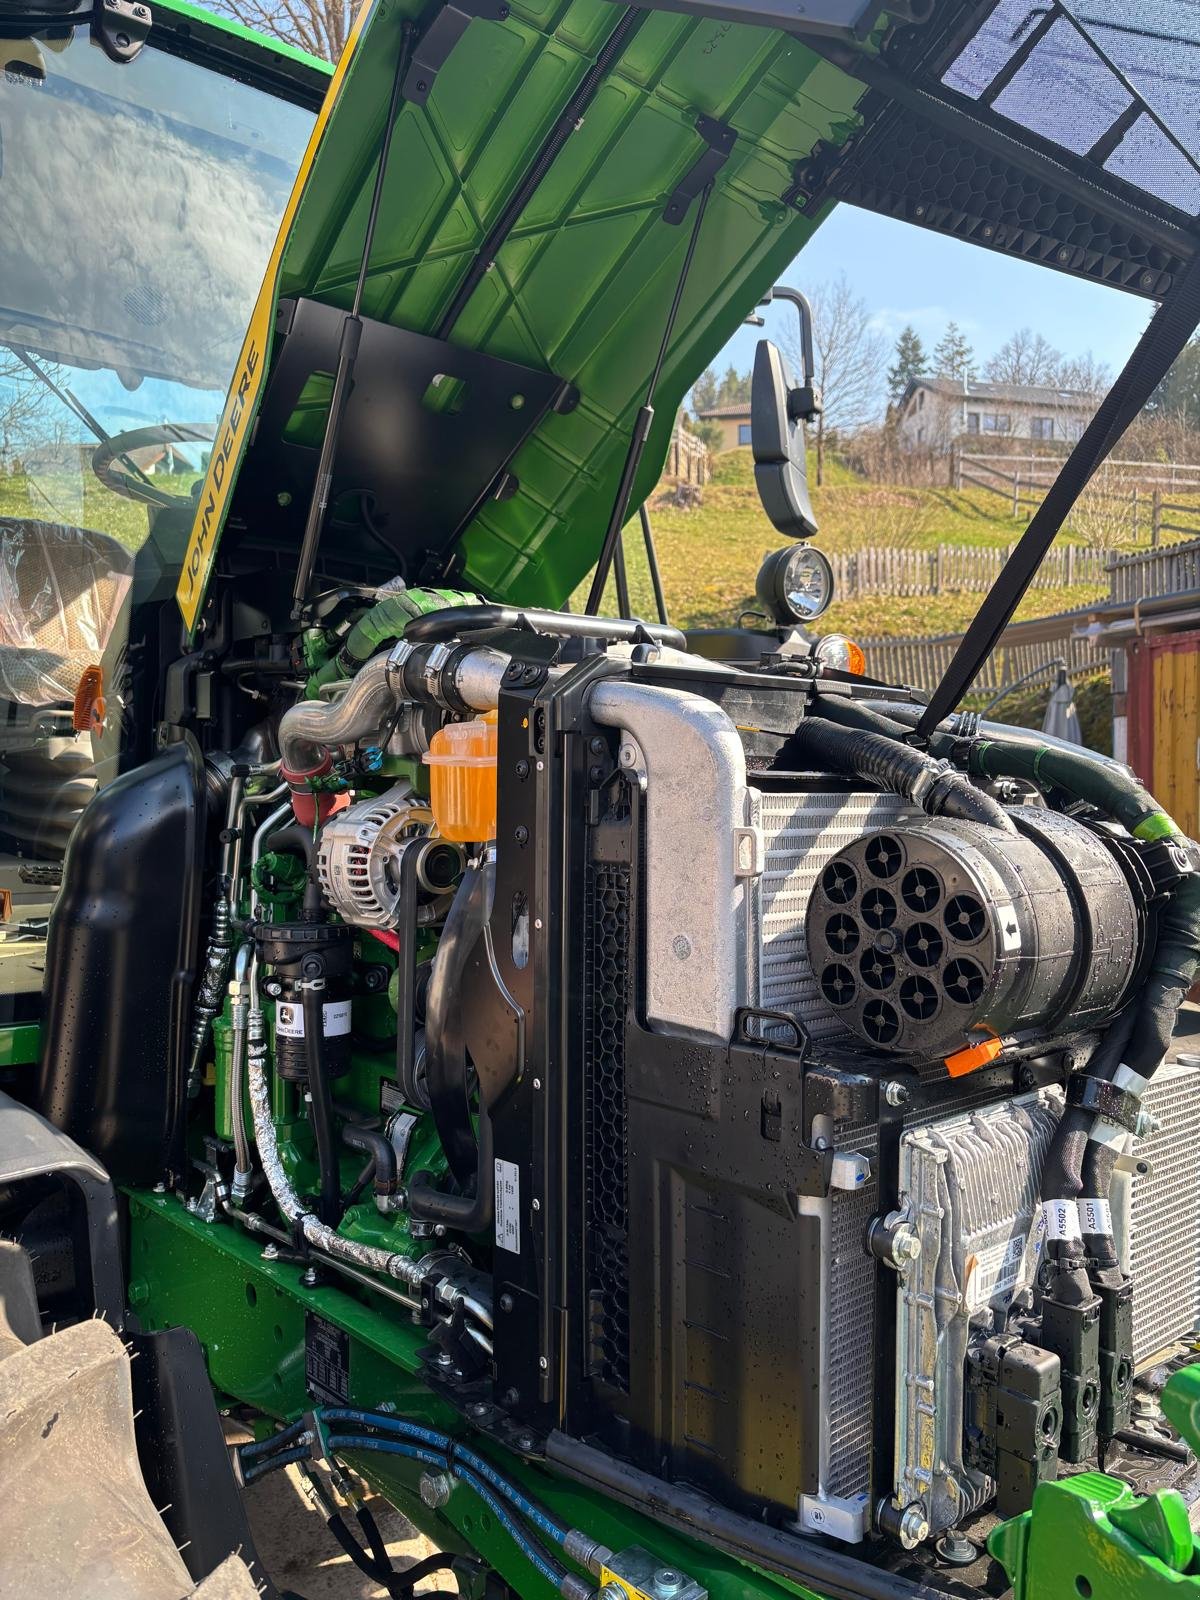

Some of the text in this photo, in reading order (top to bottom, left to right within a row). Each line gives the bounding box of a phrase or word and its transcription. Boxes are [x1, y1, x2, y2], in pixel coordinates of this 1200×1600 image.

[188, 339, 260, 600] JOHN DEERE
[1058, 1207, 1067, 1236] A5502
[1086, 1202, 1096, 1230] A5501
